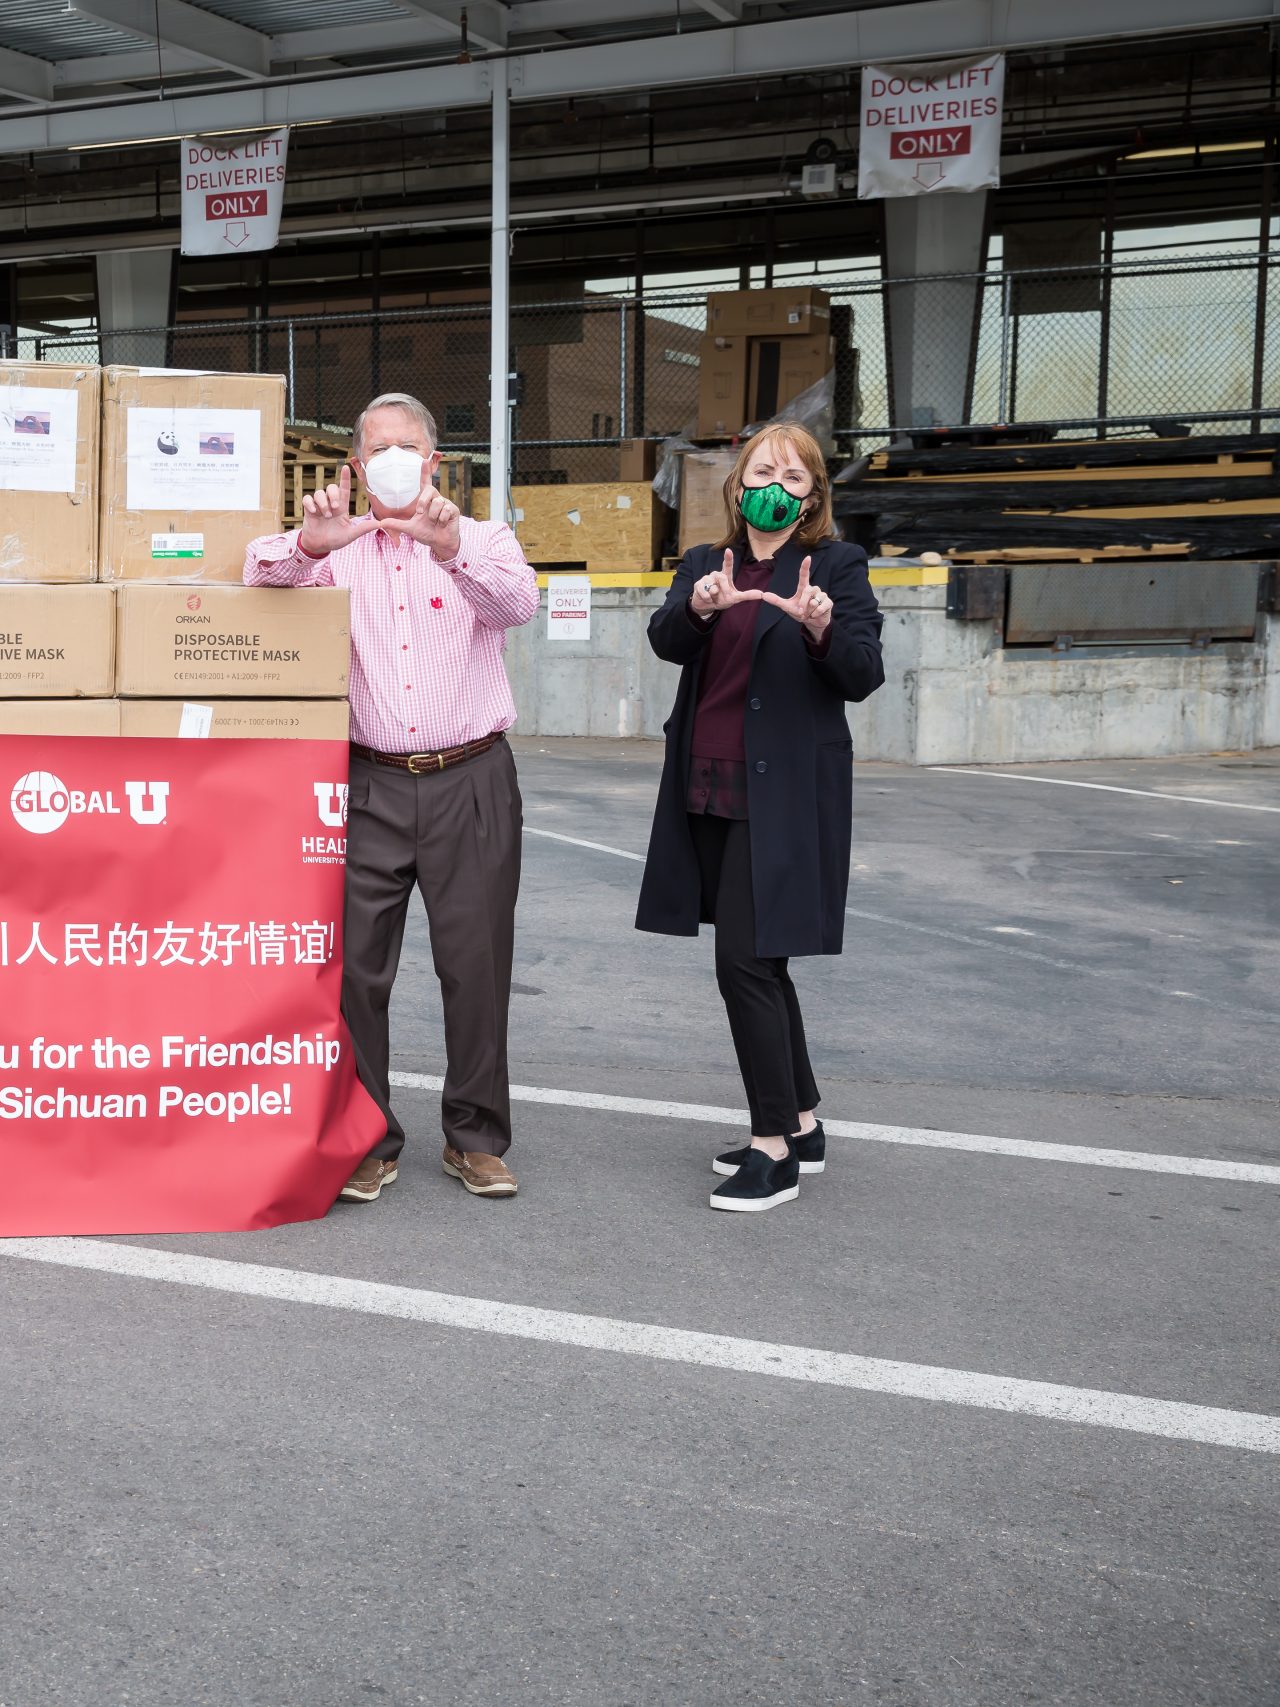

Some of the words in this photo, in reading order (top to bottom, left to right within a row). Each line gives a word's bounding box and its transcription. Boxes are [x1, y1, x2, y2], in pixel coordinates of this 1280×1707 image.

[871, 76, 938, 97] DOCK
[946, 67, 993, 90] LIFT
[866, 97, 997, 126] DELIVERIES
[189, 146, 239, 165] DOCK
[245, 140, 282, 158] LIFT
[898, 132, 962, 155] ONLY
[186, 165, 284, 190] DELIVERIES
[211, 196, 260, 216] ONLY
[556, 598, 583, 607] ONLY
[175, 615, 211, 624] ORKAN
[174, 634, 260, 646] DISPOSABLE
[26, 648, 65, 660] MASK
[174, 649, 259, 661] PROTECTIVE
[262, 650, 301, 662] MASK
[27, 672, 45, 680] FFP2
[15, 790, 121, 814] GLOBAL
[125, 781, 170, 825] U
[302, 856, 338, 864] UNIVERSITY
[29, 1037, 83, 1069] for
[91, 1036, 150, 1069] the
[161, 1033, 340, 1071] Friendship
[158, 1083, 292, 1123] People!
